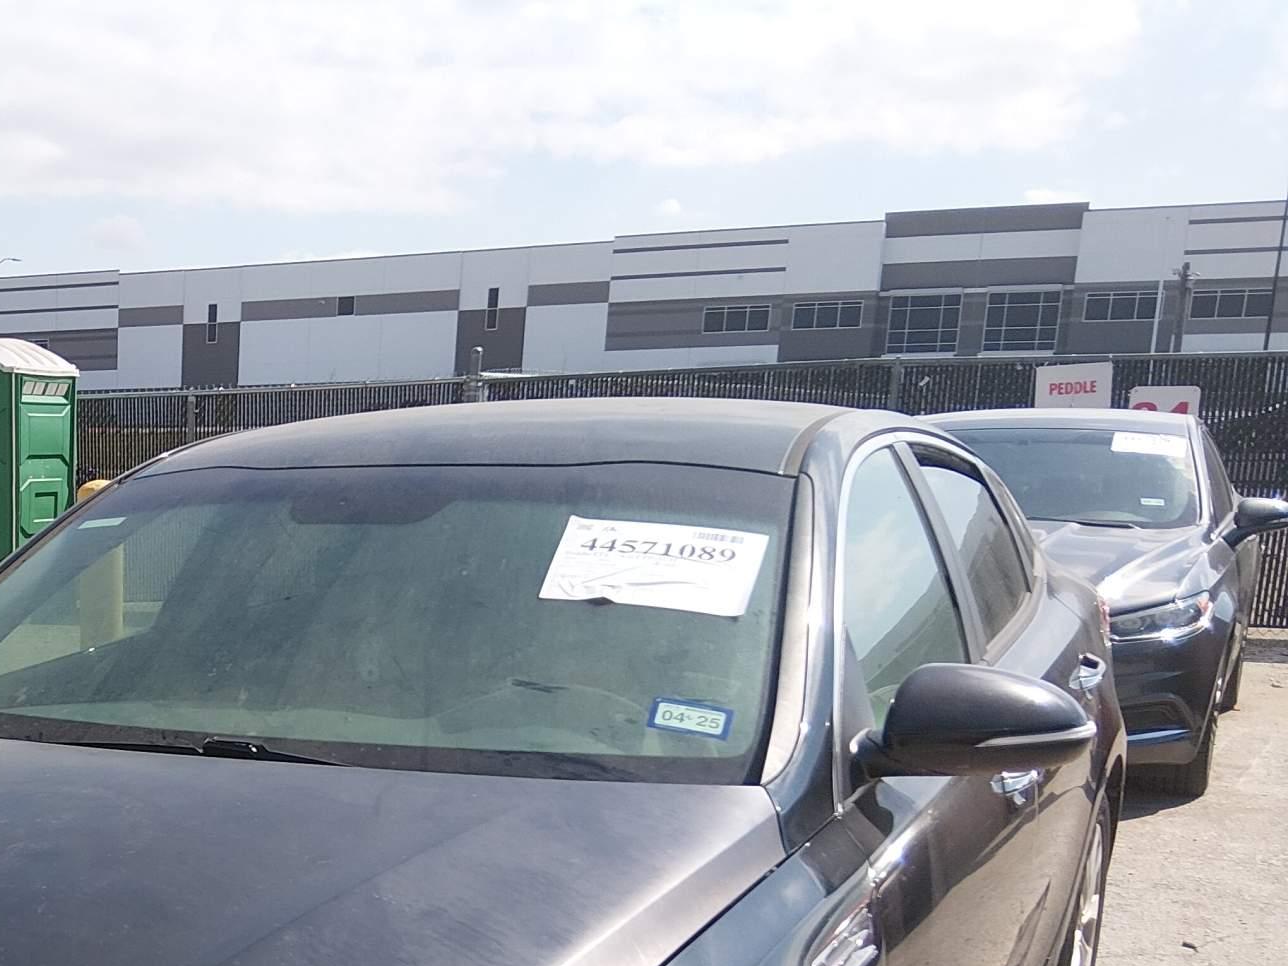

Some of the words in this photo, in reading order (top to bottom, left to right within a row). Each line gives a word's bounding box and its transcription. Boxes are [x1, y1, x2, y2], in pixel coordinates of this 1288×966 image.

[1049, 380, 1097, 396] PEDDLE
[579, 537, 737, 562] 44571089
[662, 709, 685, 723] 04
[695, 715, 721, 729] 25
